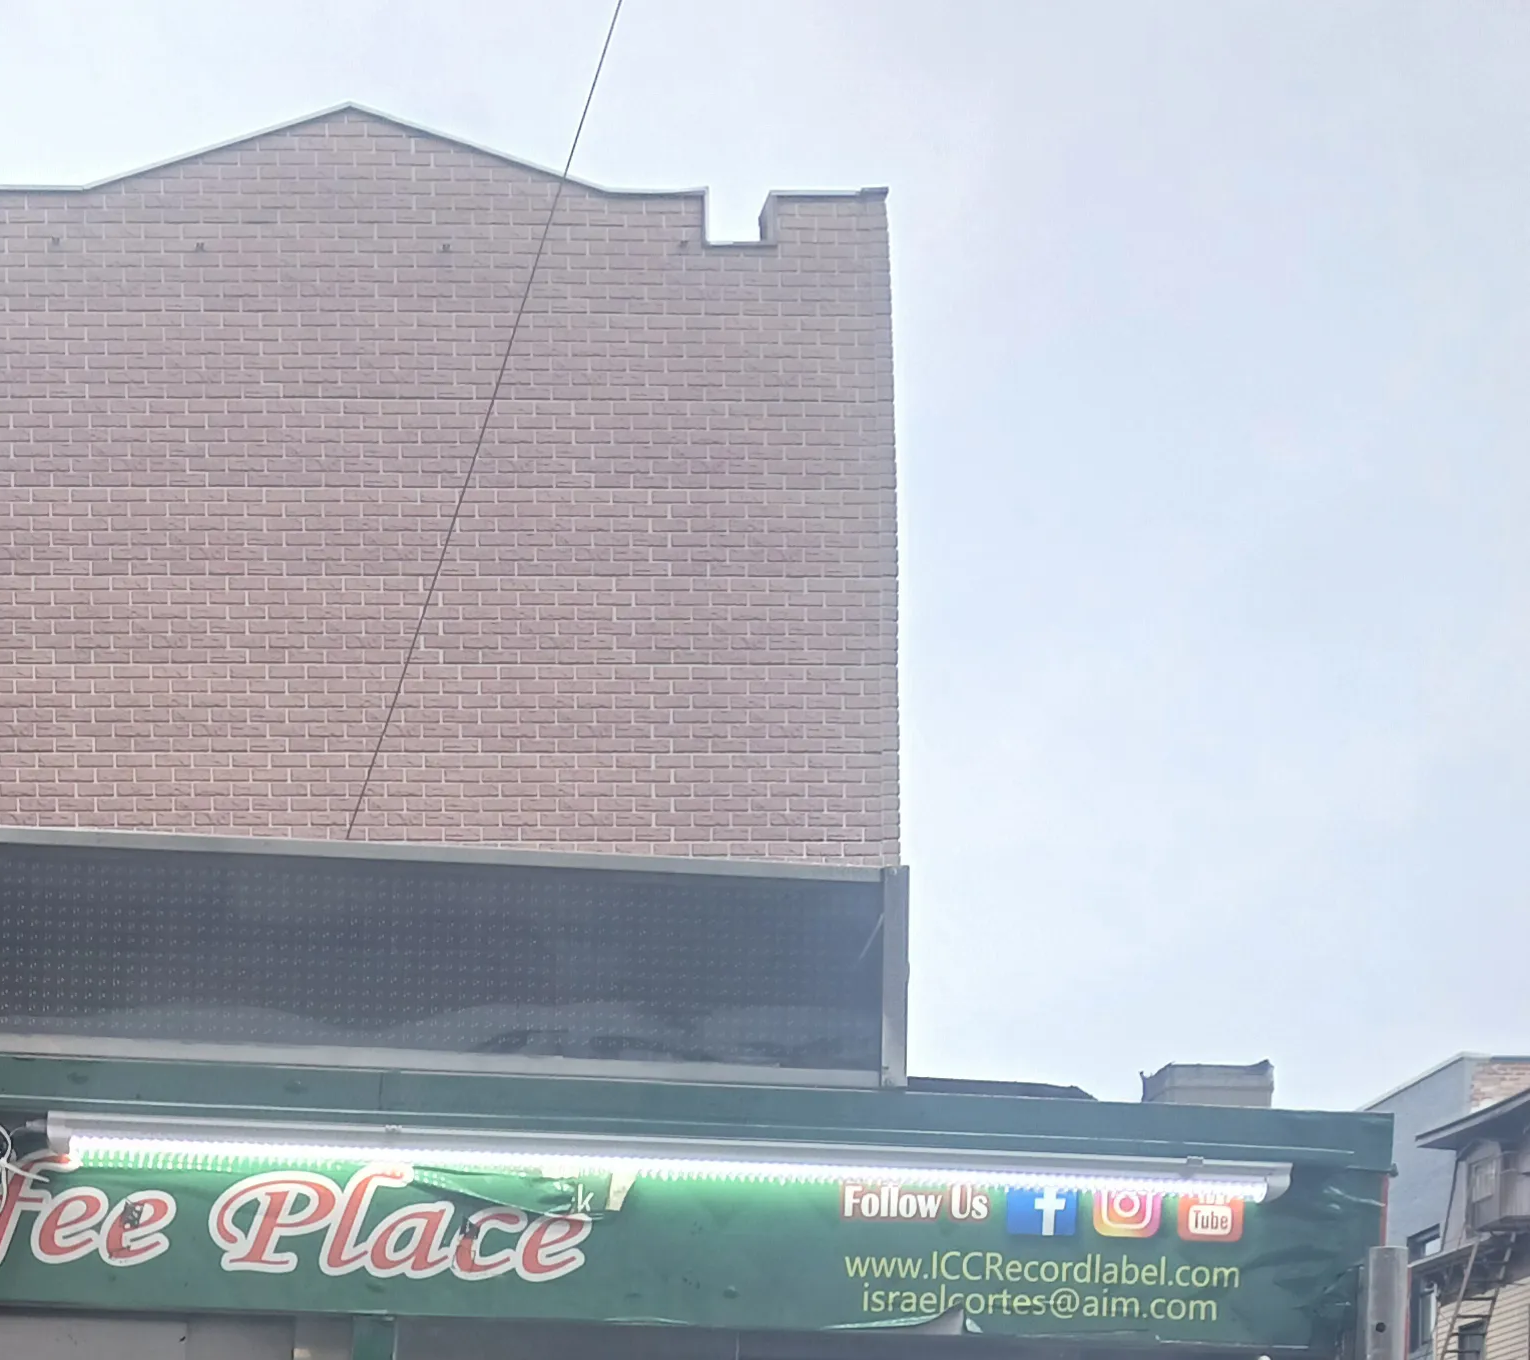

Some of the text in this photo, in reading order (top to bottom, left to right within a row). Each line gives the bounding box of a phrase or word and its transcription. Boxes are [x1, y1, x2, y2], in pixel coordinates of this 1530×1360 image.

[842, 1184, 989, 1222] Follow Us
[1192, 1209, 1229, 1231] Tube
[209, 1161, 593, 1284] Place
[845, 1251, 1239, 1288] www.ICCRecordlabel.com
